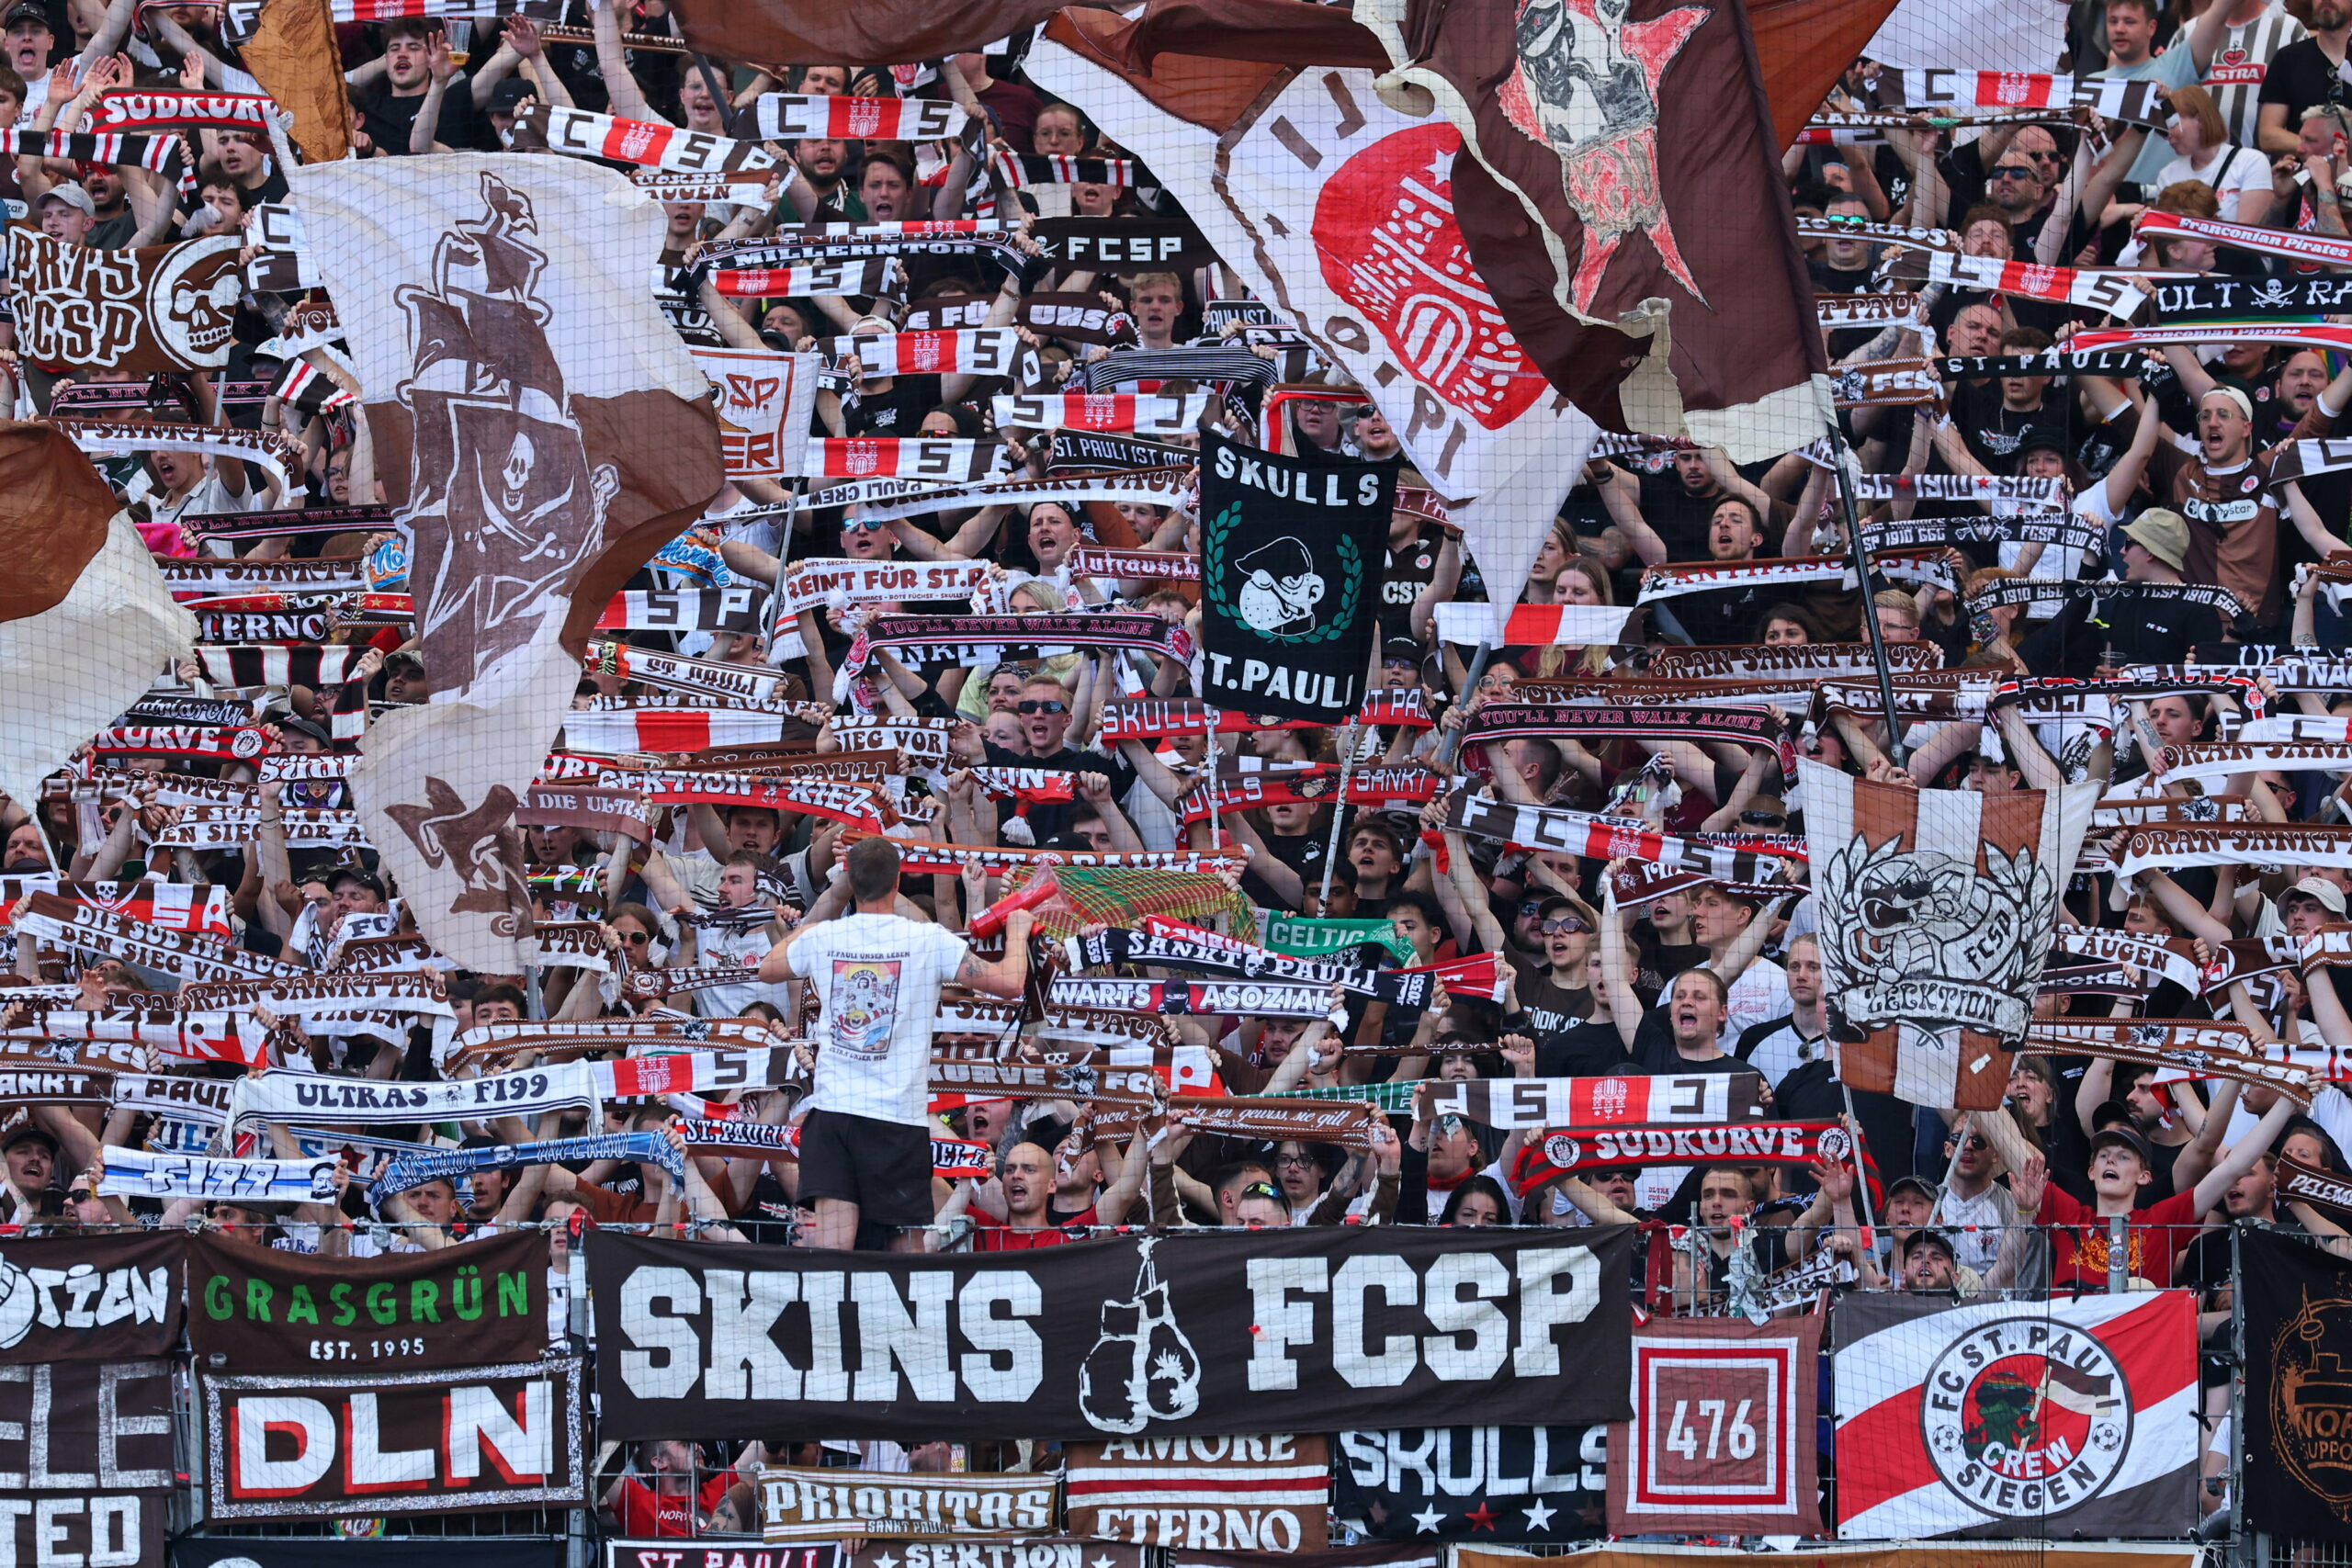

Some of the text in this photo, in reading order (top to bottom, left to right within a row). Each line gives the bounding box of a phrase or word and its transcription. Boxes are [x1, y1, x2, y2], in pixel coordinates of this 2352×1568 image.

[734, 243, 978, 268] MILLERNTOR
[1068, 236, 1182, 262] FCSP
[2178, 217, 2349, 260] Franconian Pirates
[10, 291, 143, 367] FCSP
[1029, 304, 1109, 331] UNS
[1053, 437, 1078, 458] ST.
[1079, 437, 1128, 462] PAULI
[1130, 446, 1159, 466] IST
[1216, 446, 1379, 506] SKULLS
[864, 564, 919, 591] FÜR
[880, 616, 1154, 637] YOU'LL NEVER WALK ALONE
[1739, 644, 1840, 673] SANKT
[646, 658, 759, 696] ST. PAULI
[131, 699, 247, 727] atriarchy
[1102, 702, 1221, 736] SKULLS
[1478, 709, 1765, 732] YOU'LL NEVER WALK ALONE
[892, 730, 942, 753] VOR
[598, 770, 874, 818] SEKTION KIEZ
[1181, 777, 1263, 820] ULLS
[1355, 768, 1430, 795] SANKT
[537, 793, 579, 810] DIE
[2231, 829, 2341, 855] SANKT
[59, 924, 114, 954] DEN
[121, 941, 184, 975] SIEG
[74, 905, 227, 962] DIE SÜD IM
[1272, 921, 1364, 948] CELTIC
[1126, 931, 1241, 969] SANKT
[1275, 957, 1378, 993] PAULI
[2077, 937, 2171, 973] AUGEN
[270, 975, 381, 1001] SANKT
[1201, 980, 1330, 1013] ASOZIAL
[295, 1073, 548, 1109] ULTRAS FI99
[1292, 1109, 1317, 1123] sie
[1317, 1109, 1351, 1130] gilt
[1595, 1125, 1804, 1160] SÜDKURVE
[204, 1265, 529, 1325] GRASGRÜN
[620, 1265, 1044, 1403] SKINS
[1247, 1244, 1601, 1392] FCSP
[309, 1337, 425, 1360] EST. 1995
[1932, 1325, 2122, 1414] FC ST. PAUI
[230, 1380, 554, 1499] DLN
[1666, 1398, 1757, 1461] 476
[1340, 1425, 1608, 1497] SKULLS
[1982, 1434, 2073, 1480] CREW
[1956, 1459, 2099, 1511] SIEGEN
[763, 1480, 1052, 1530] PRIORITAS
[866, 1519, 951, 1536] SANKT PAULI
[1096, 1508, 1302, 1554] ETERNO
